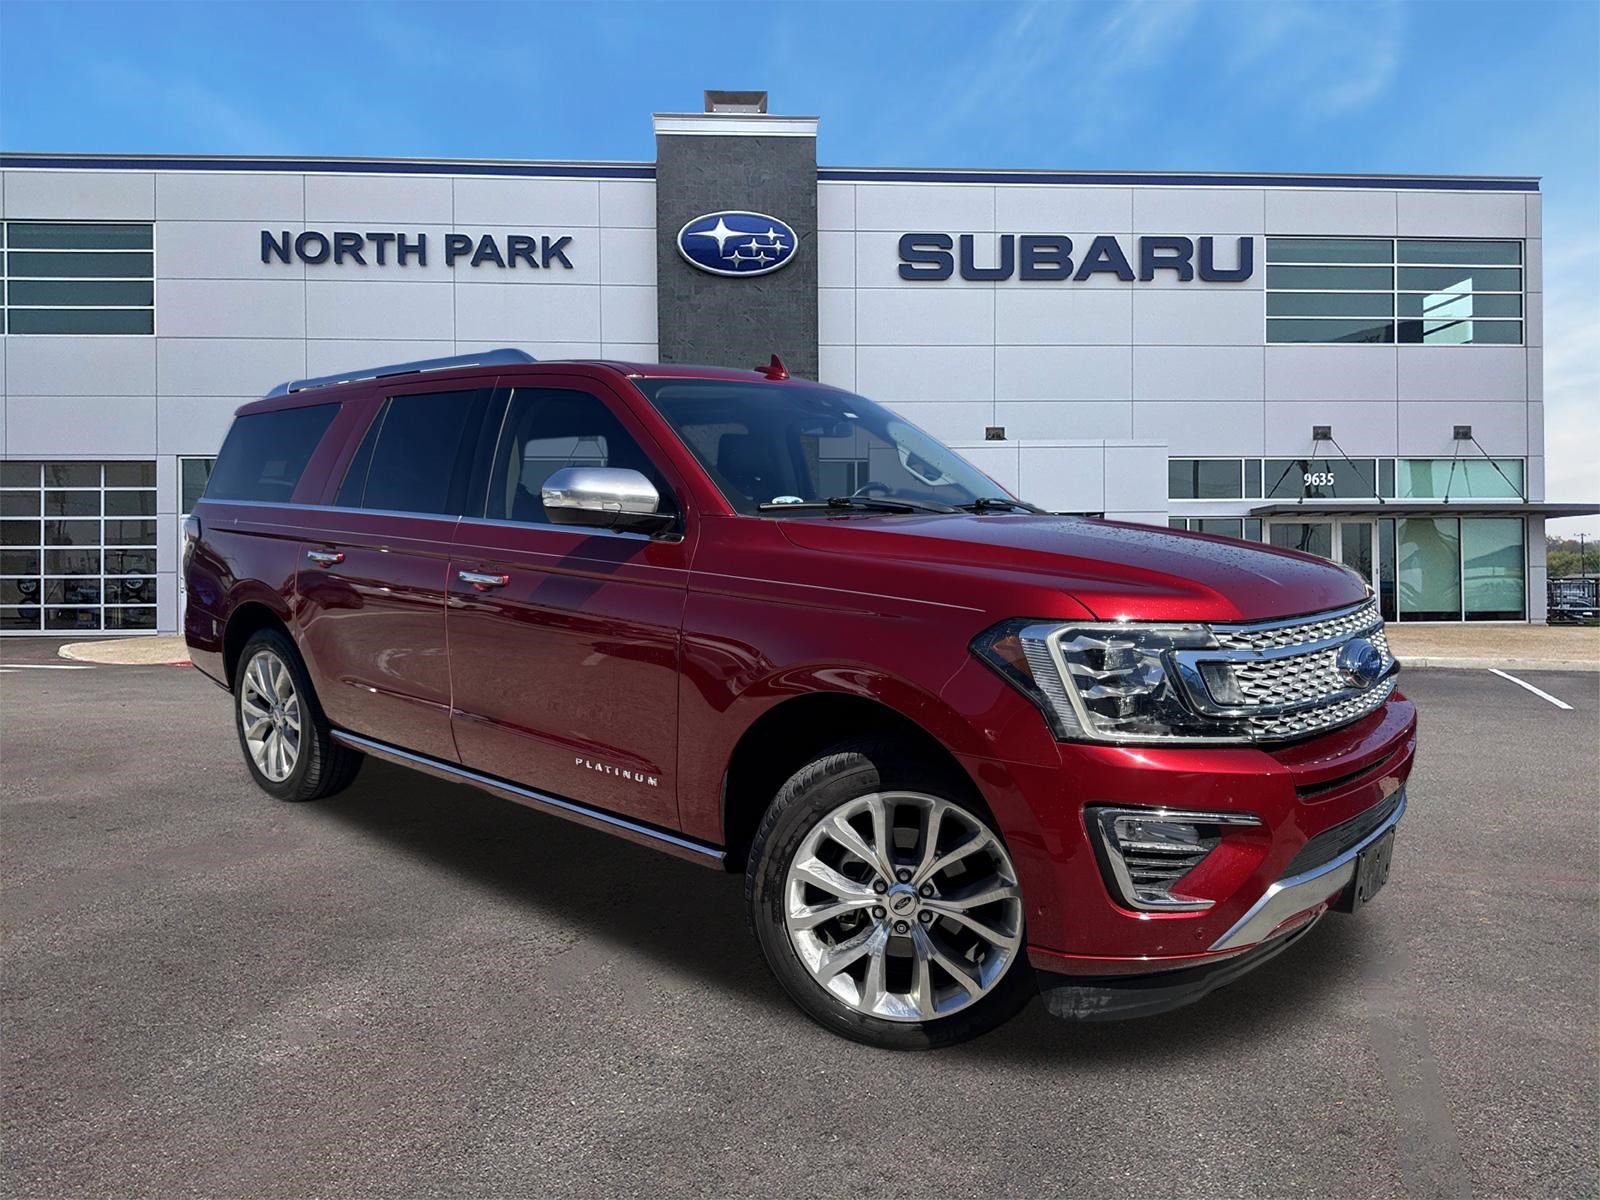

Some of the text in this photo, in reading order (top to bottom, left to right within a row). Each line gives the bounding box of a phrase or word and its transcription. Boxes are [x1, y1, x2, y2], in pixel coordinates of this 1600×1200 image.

[260, 230, 574, 269] NORTH PARK
[898, 232, 1254, 282] SUBARU
[1303, 472, 1335, 486] 9635
[575, 757, 658, 787] PLATINUM
